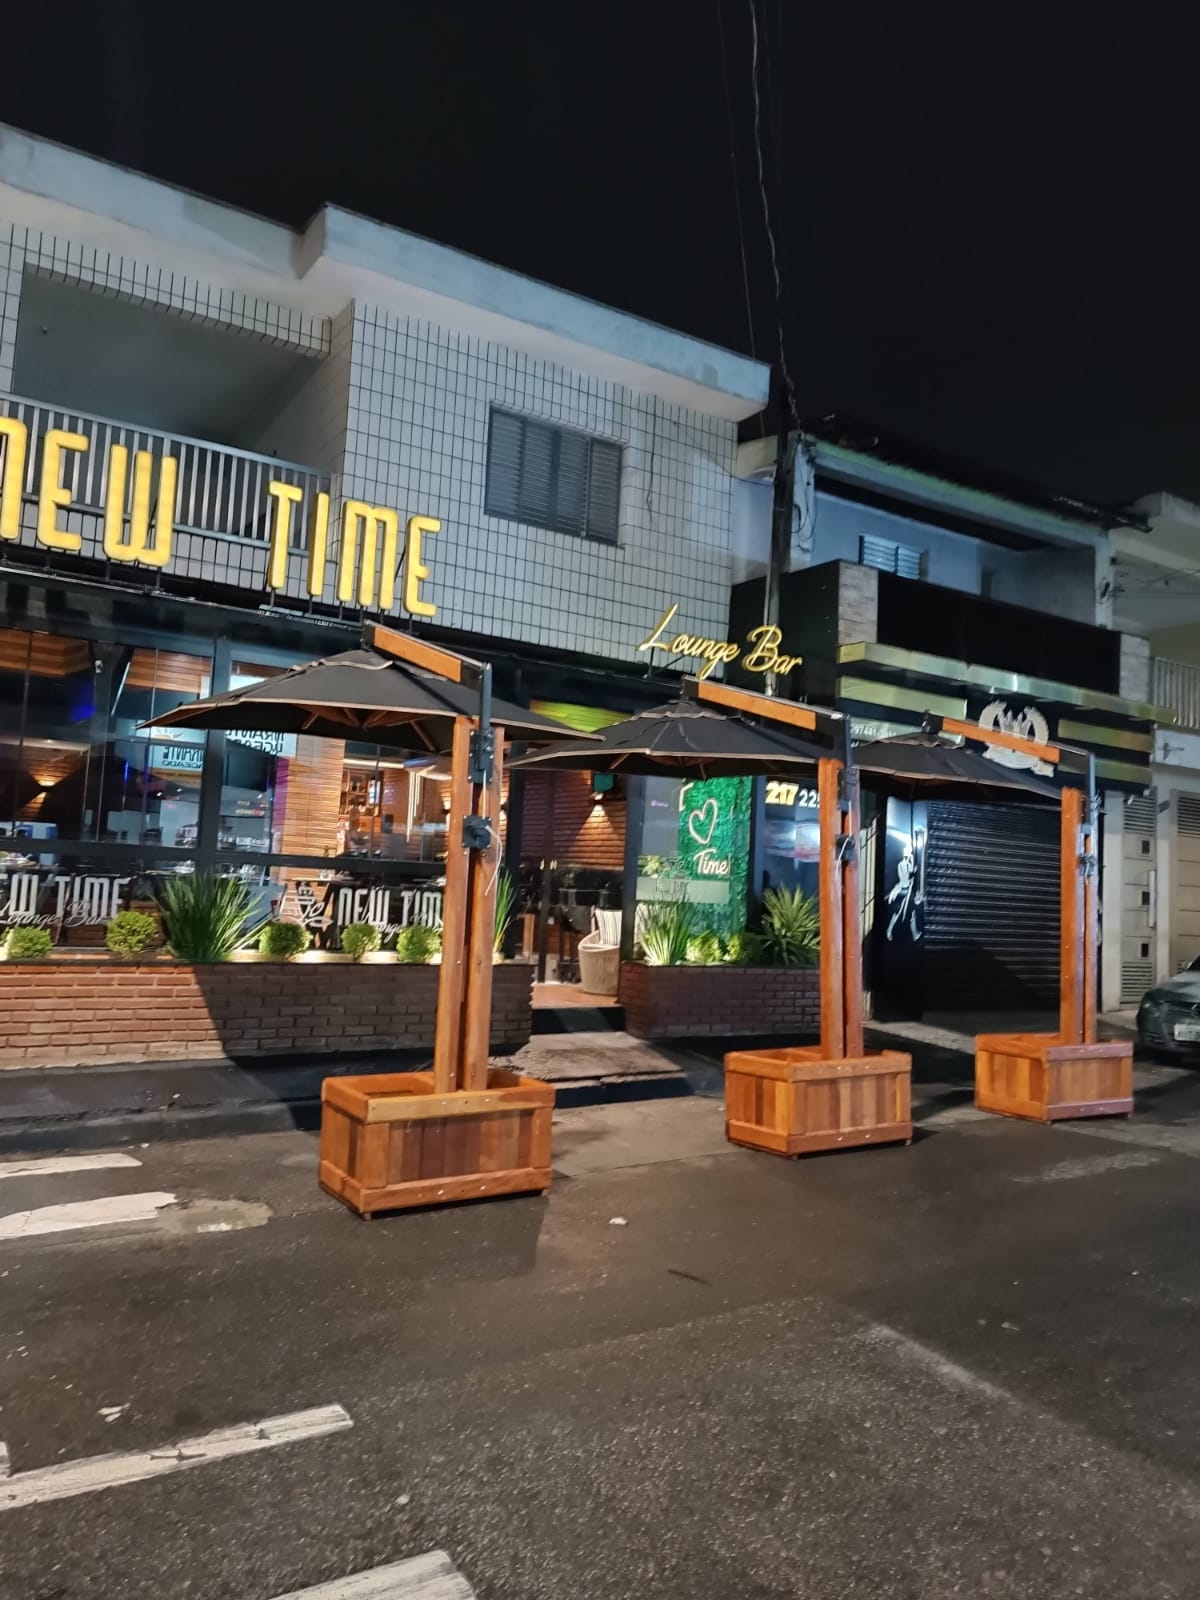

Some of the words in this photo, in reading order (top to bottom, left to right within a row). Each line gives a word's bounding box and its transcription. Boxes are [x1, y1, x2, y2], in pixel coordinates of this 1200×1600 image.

[268, 480, 442, 618] TIME
[637, 603, 742, 680] Lounge
[742, 624, 803, 676] Bar
[693, 848, 729, 875] Time
[400, 890, 443, 928] TIM
